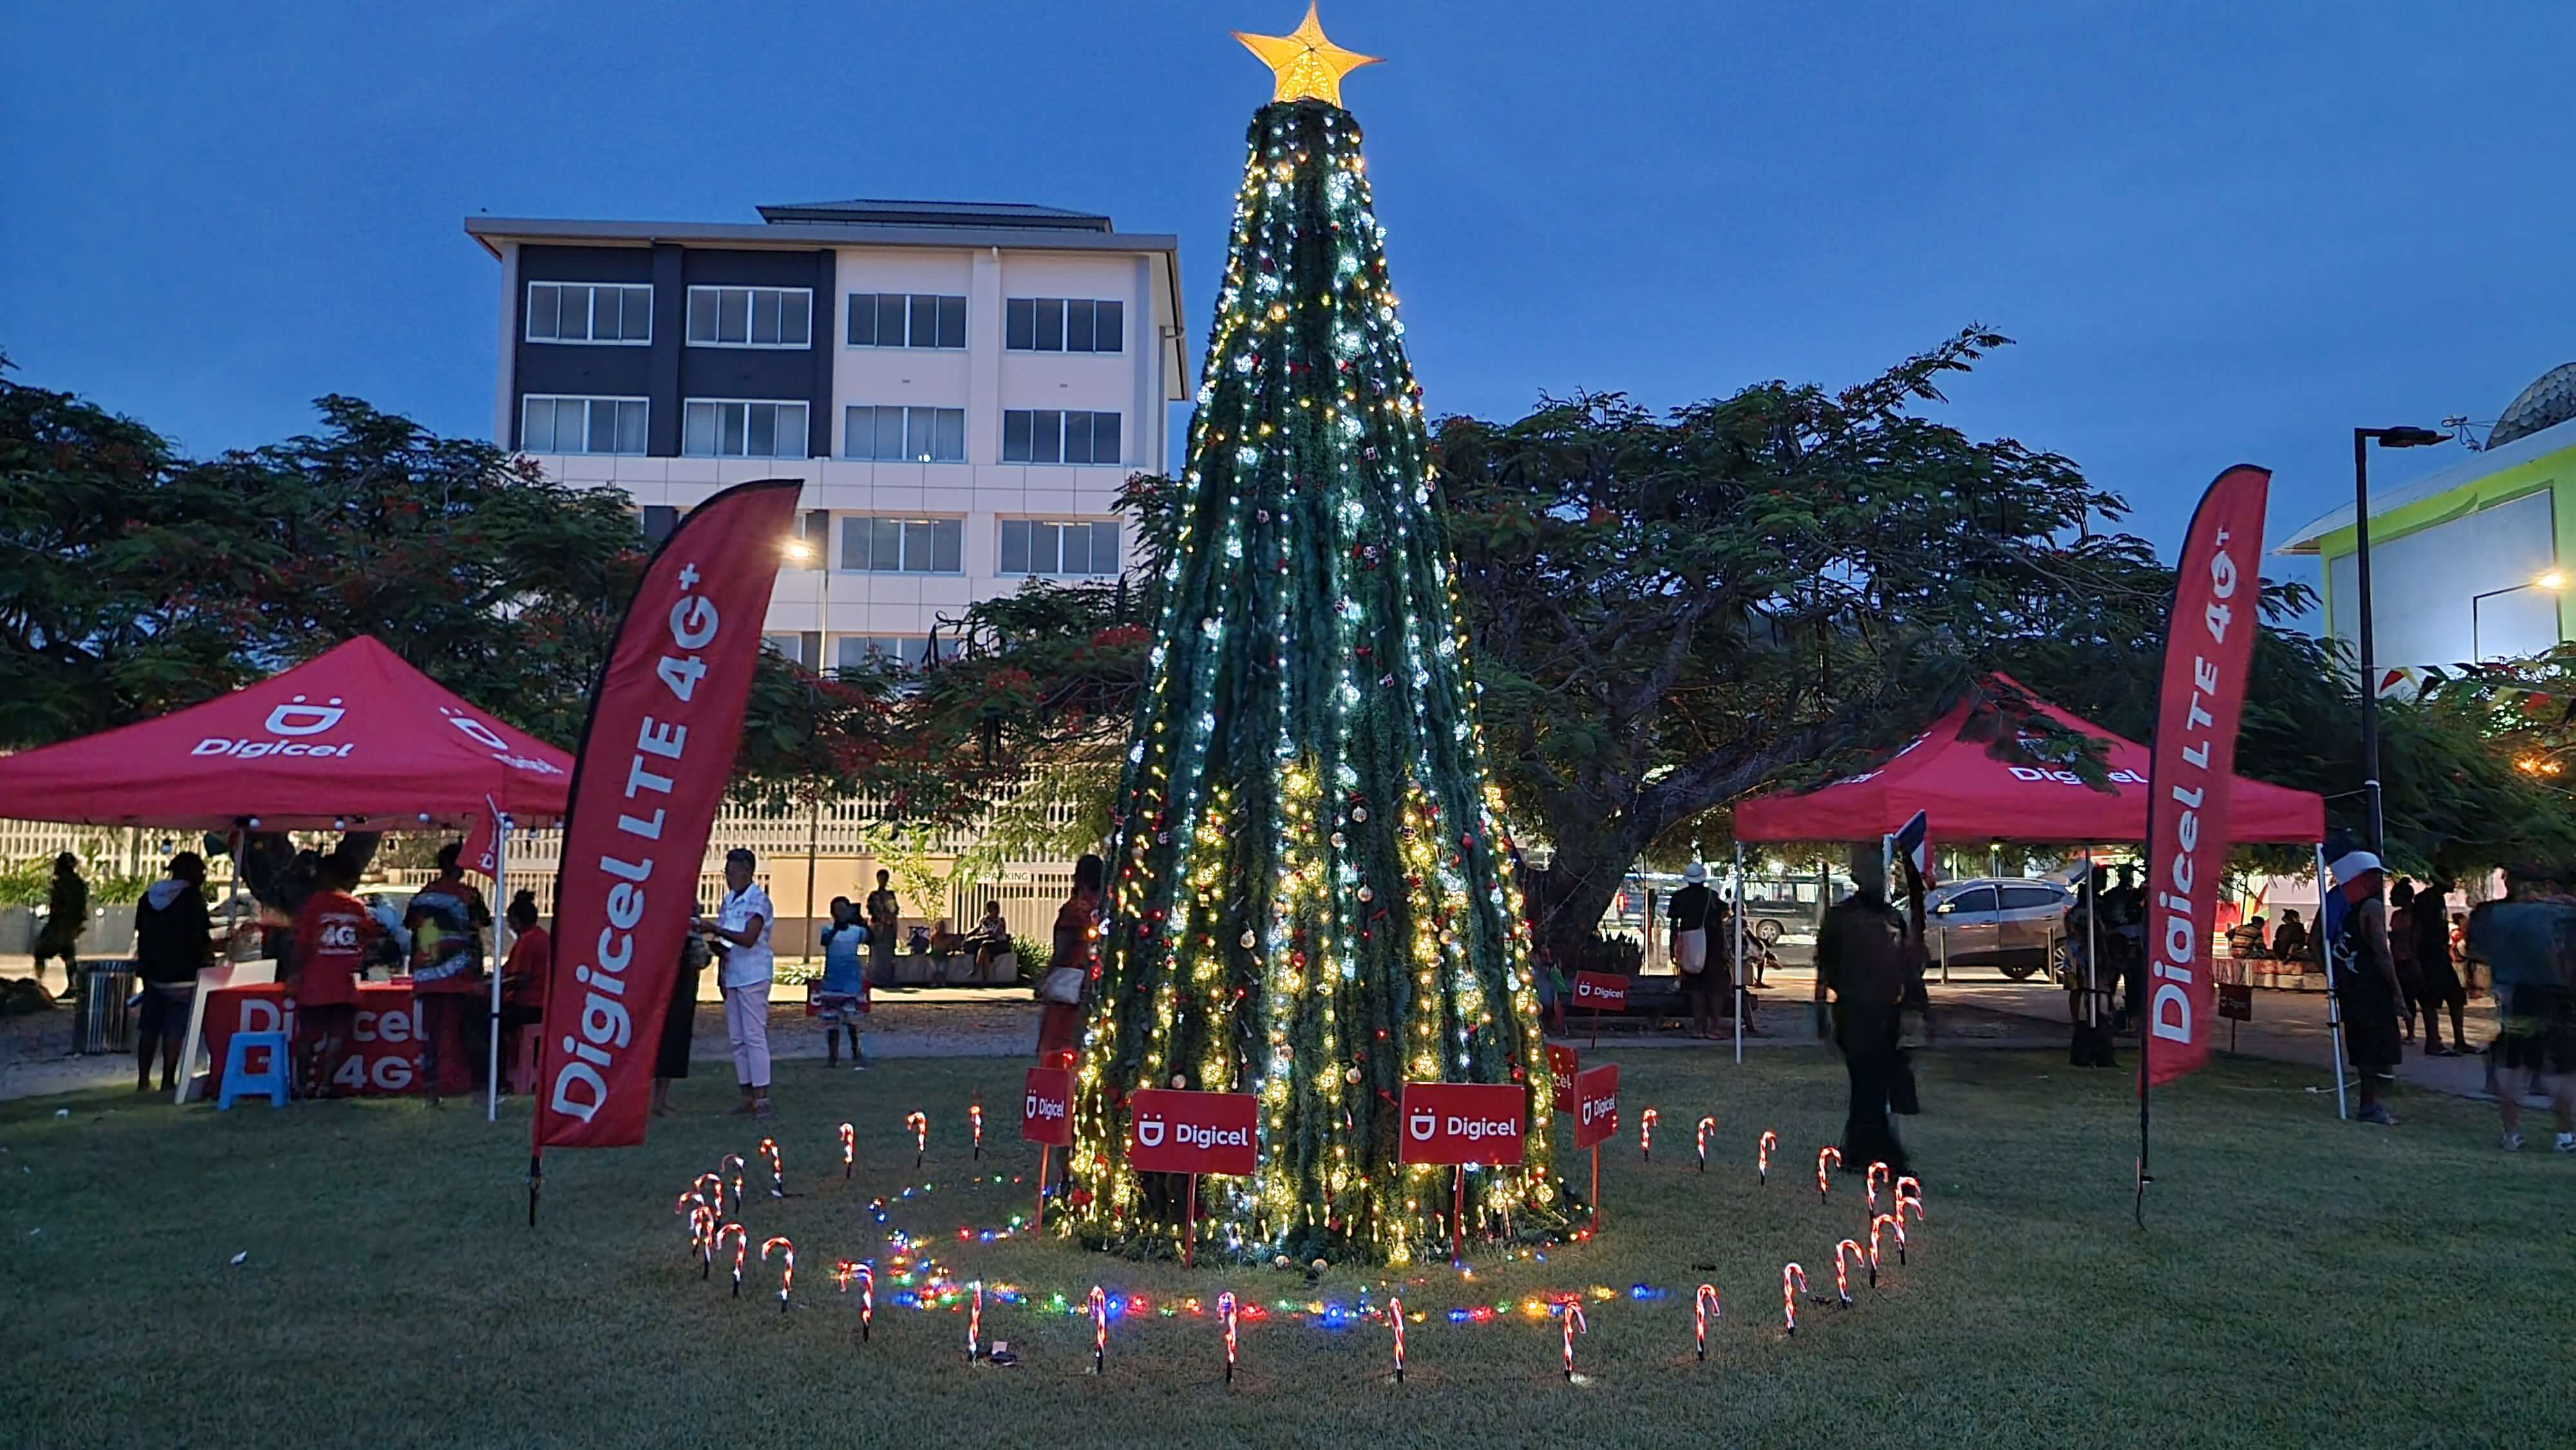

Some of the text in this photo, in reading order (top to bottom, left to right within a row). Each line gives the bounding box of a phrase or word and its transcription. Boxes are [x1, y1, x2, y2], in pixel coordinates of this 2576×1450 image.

[2182, 655, 2219, 769] LTE
[190, 738, 354, 759] Digicel
[2008, 767, 2149, 786] Digel
[985, 871, 1028, 881] PAKING
[551, 855, 654, 1124] Digicel
[617, 715, 688, 840] LTE
[1594, 986, 1624, 999] Digicel
[238, 998, 430, 1051] Dicel
[1038, 1098, 1064, 1120] Digicel
[1594, 1093, 1615, 1119] Digicel
[1176, 1124, 1249, 1149] Digicel
[1447, 1116, 1517, 1141] Digicel
